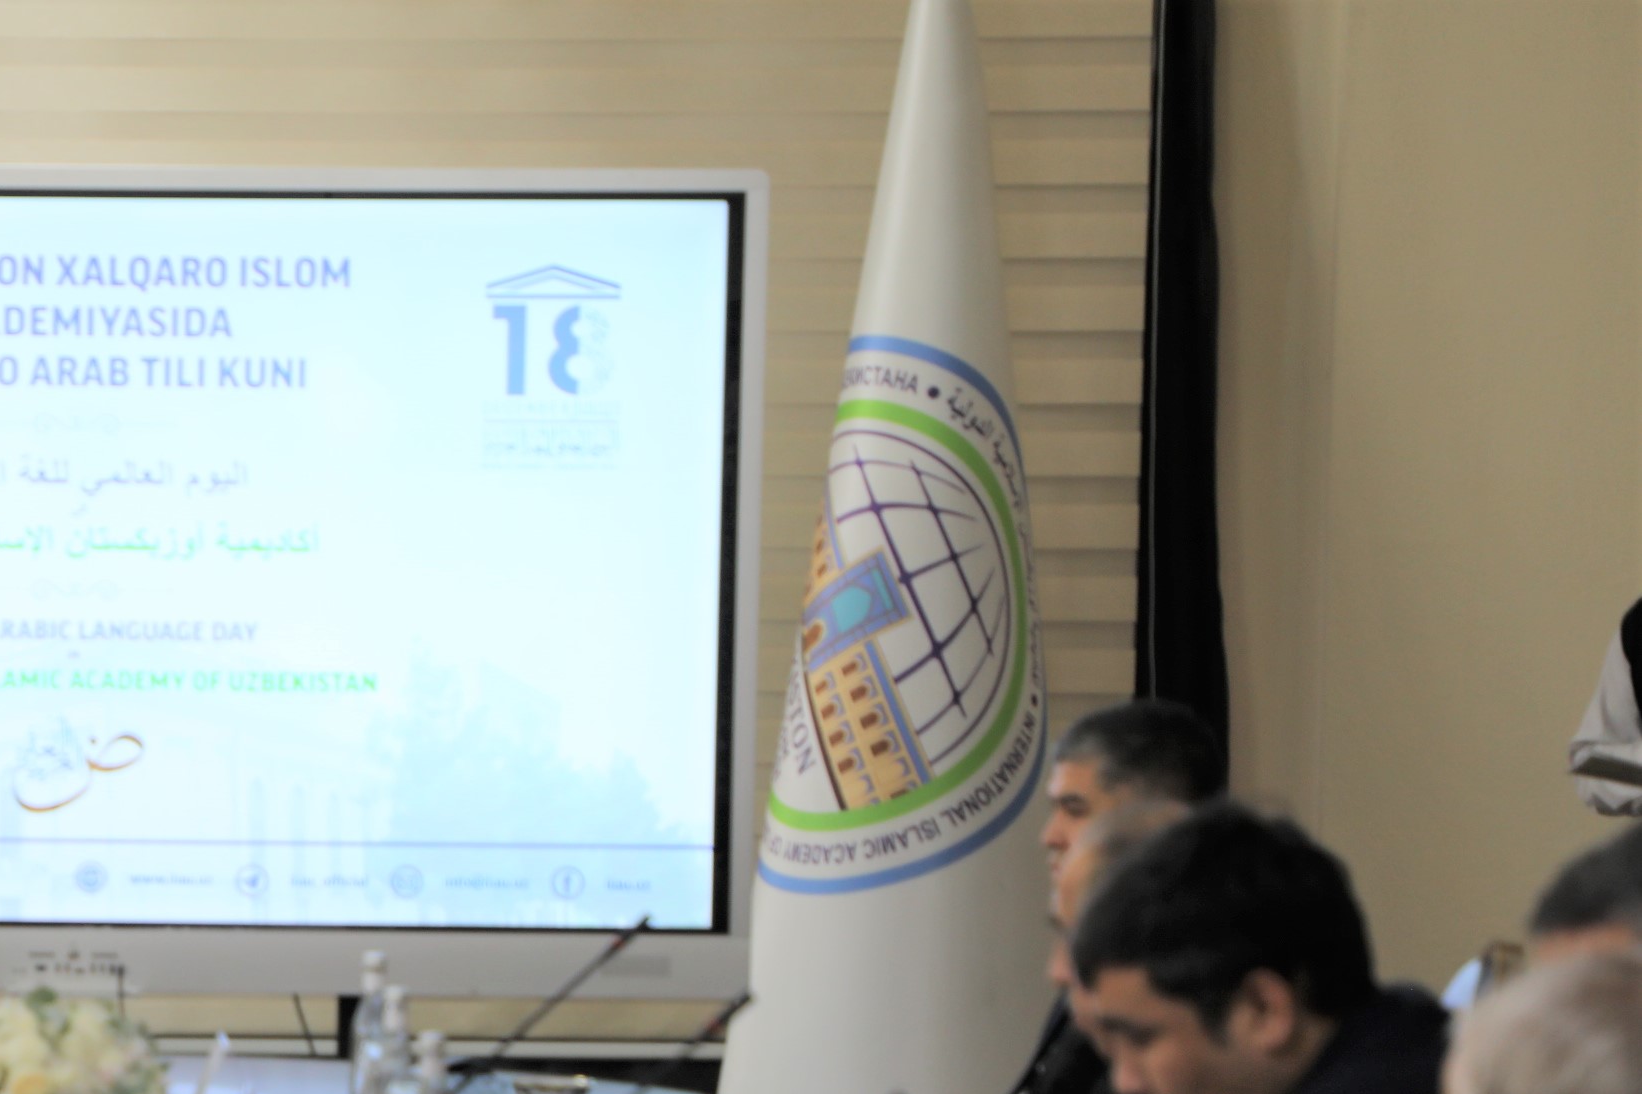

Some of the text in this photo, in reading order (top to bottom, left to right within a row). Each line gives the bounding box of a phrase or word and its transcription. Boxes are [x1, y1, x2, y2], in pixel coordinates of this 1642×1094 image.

[57, 255, 227, 291] XALQARO
[240, 257, 351, 288] ISLOM
[30, 356, 131, 386] ARAB
[141, 357, 206, 387] TILI
[218, 358, 307, 388] KUNI
[78, 620, 203, 643] LANGUAGE
[212, 621, 257, 643] DAY
[68, 669, 186, 692] ACADEMY
[191, 670, 222, 693] OF
[228, 671, 379, 695] UZBEKISTAN
[940, 710, 1037, 829] INTERNATIONAL
[864, 813, 942, 859] ISLAMIC
[783, 840, 858, 865] ACADEMY
